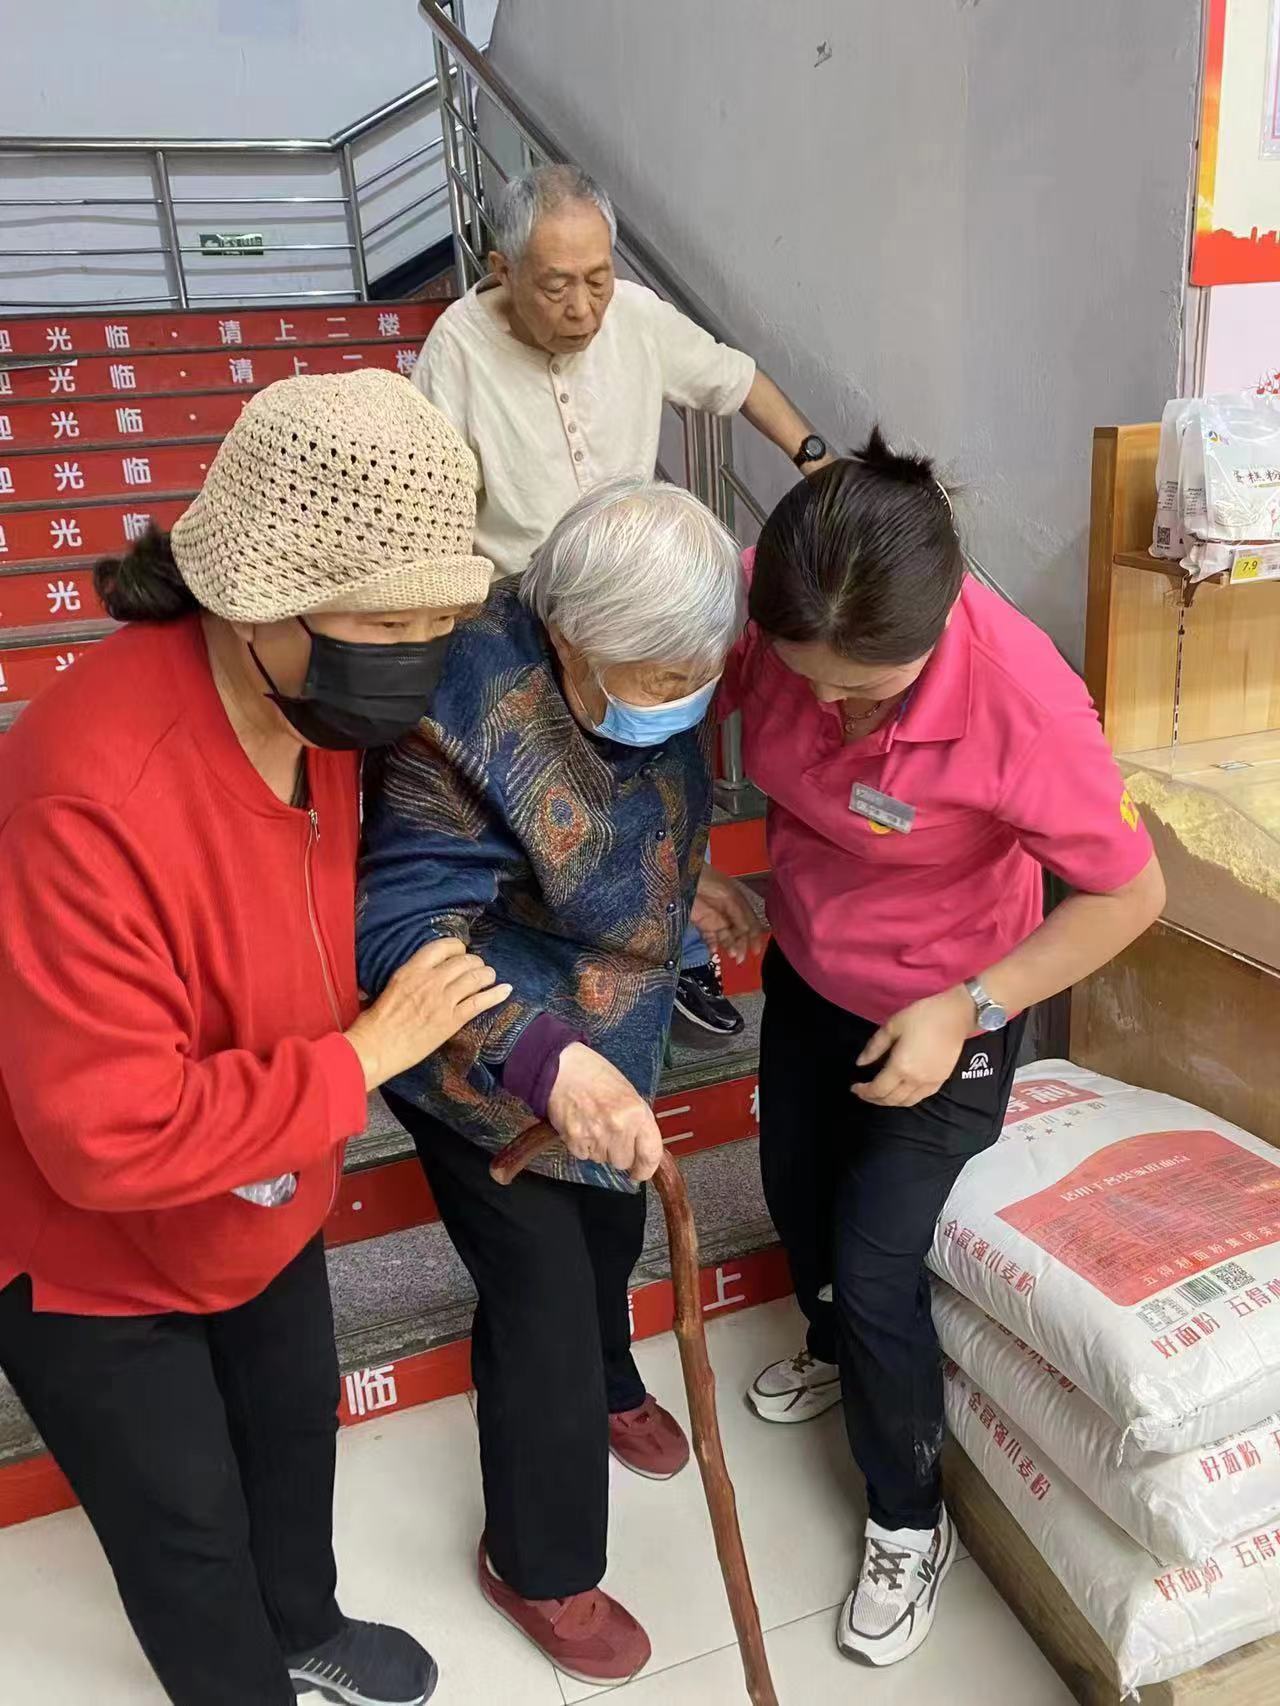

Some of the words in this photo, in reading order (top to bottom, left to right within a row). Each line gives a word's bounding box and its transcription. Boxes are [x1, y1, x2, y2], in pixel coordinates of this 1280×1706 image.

[0, 513, 150, 552] 光临
[1242, 560, 1258, 572] 7.9
[47, 580, 81, 614] 光
[1151, 1312, 1221, 1359] 好面粉
[345, 1364, 398, 1416] 临
[1200, 1440, 1262, 1483] 好面粉
[1154, 1556, 1223, 1601] 好面粉
